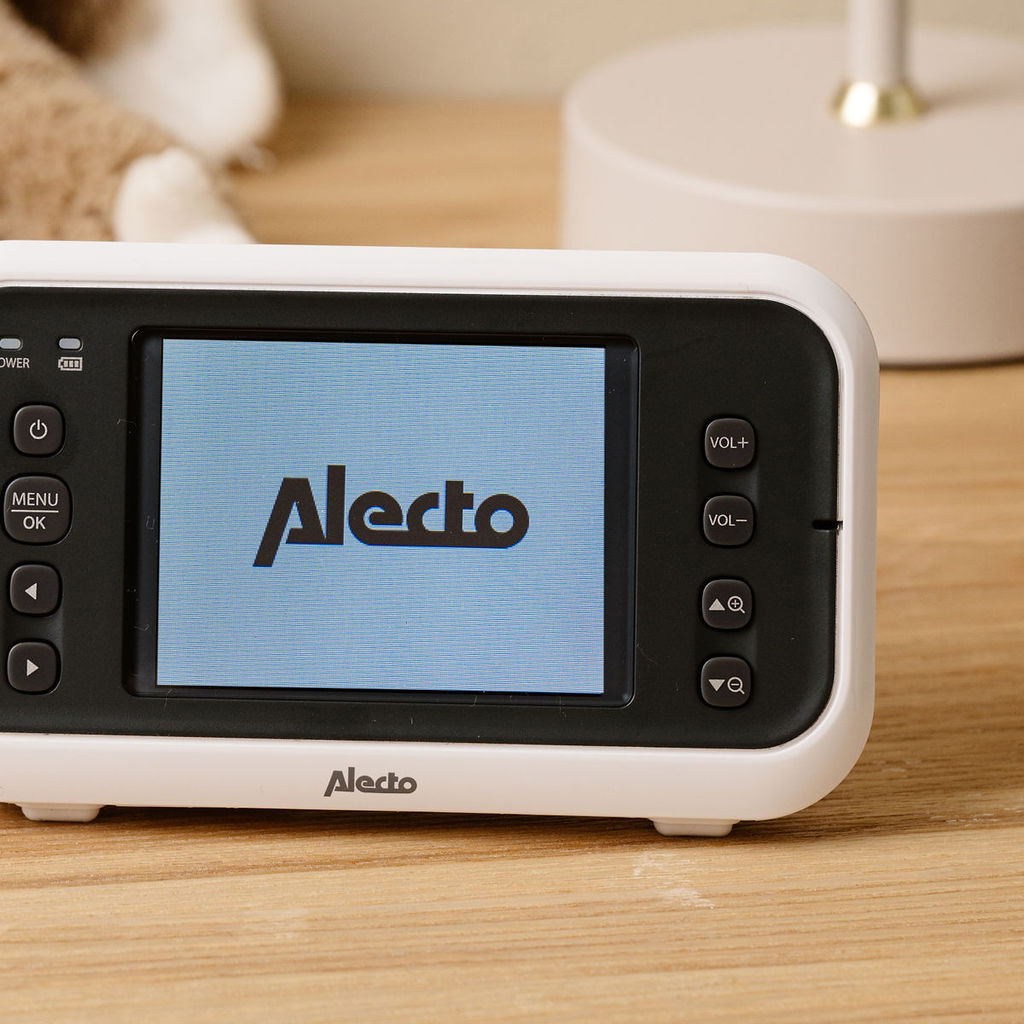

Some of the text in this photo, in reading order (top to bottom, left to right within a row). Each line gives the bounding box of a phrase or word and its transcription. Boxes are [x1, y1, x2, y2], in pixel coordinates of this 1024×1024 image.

[12, 491, 59, 507] MENU
[22, 515, 46, 530] OK
[252, 464, 530, 568] Alecto
[323, 766, 418, 798] Alecto
